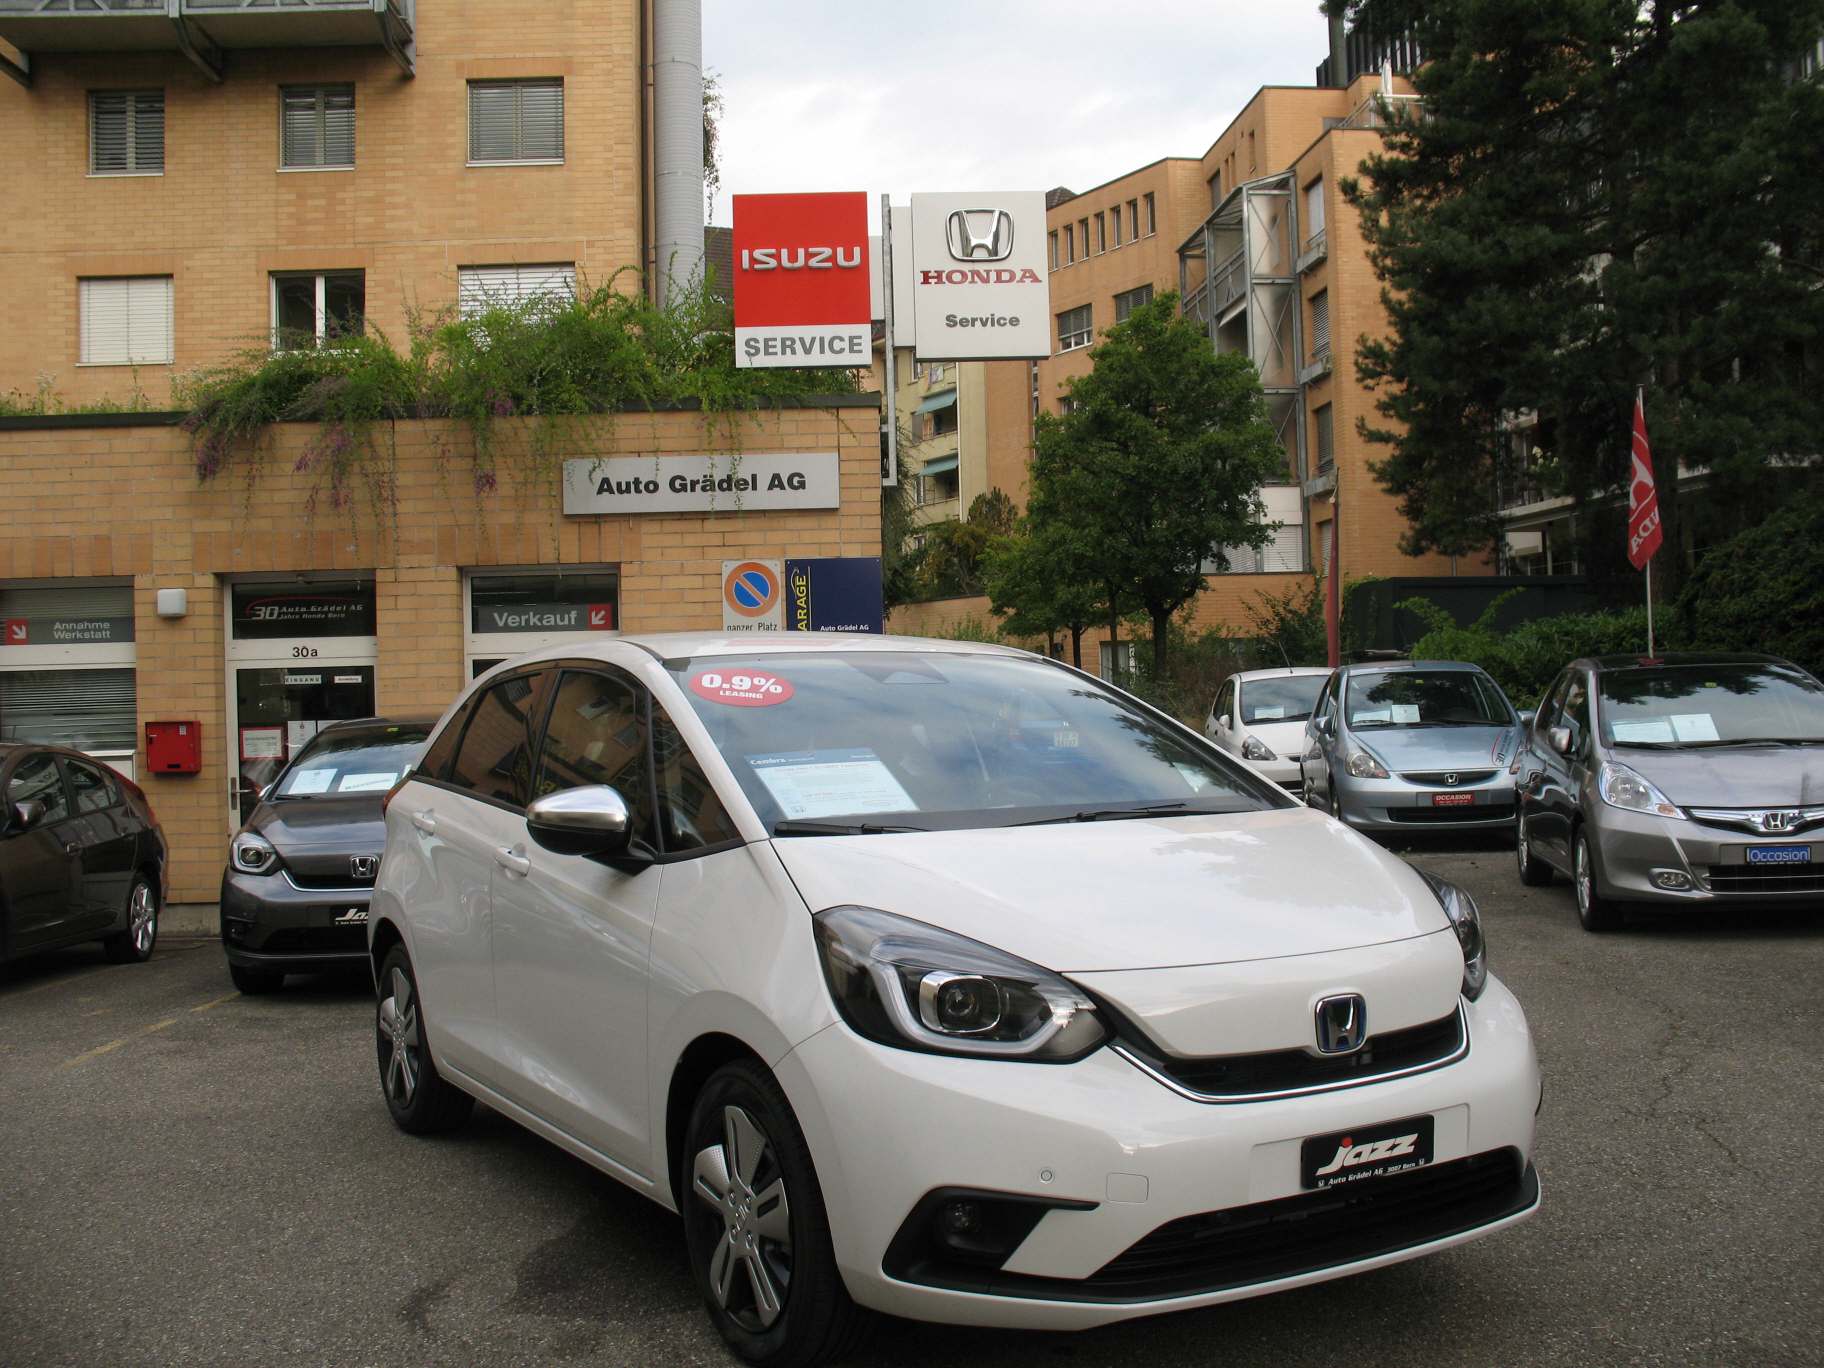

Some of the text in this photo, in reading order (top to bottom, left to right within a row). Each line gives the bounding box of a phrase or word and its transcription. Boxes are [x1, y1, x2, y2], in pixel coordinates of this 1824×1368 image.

[741, 246, 861, 270] ISUZU
[920, 269, 1042, 285] HONDA
[945, 313, 1021, 328] Service
[744, 335, 864, 357] SERVICE
[597, 472, 806, 495] Auto Grädel AG
[251, 606, 279, 620] 30
[494, 610, 577, 627] Verkauf
[54, 621, 111, 630] Annahme
[758, 622, 777, 631] Platz
[53, 630, 111, 639] Werkstatt
[292, 646, 318, 657] 30a
[701, 673, 783, 693] 0.9%
[719, 690, 763, 699] LEASING
[1750, 849, 1808, 862] Occasion
[1328, 1177, 1346, 1186] Auto
[1373, 1167, 1384, 1176] AG
